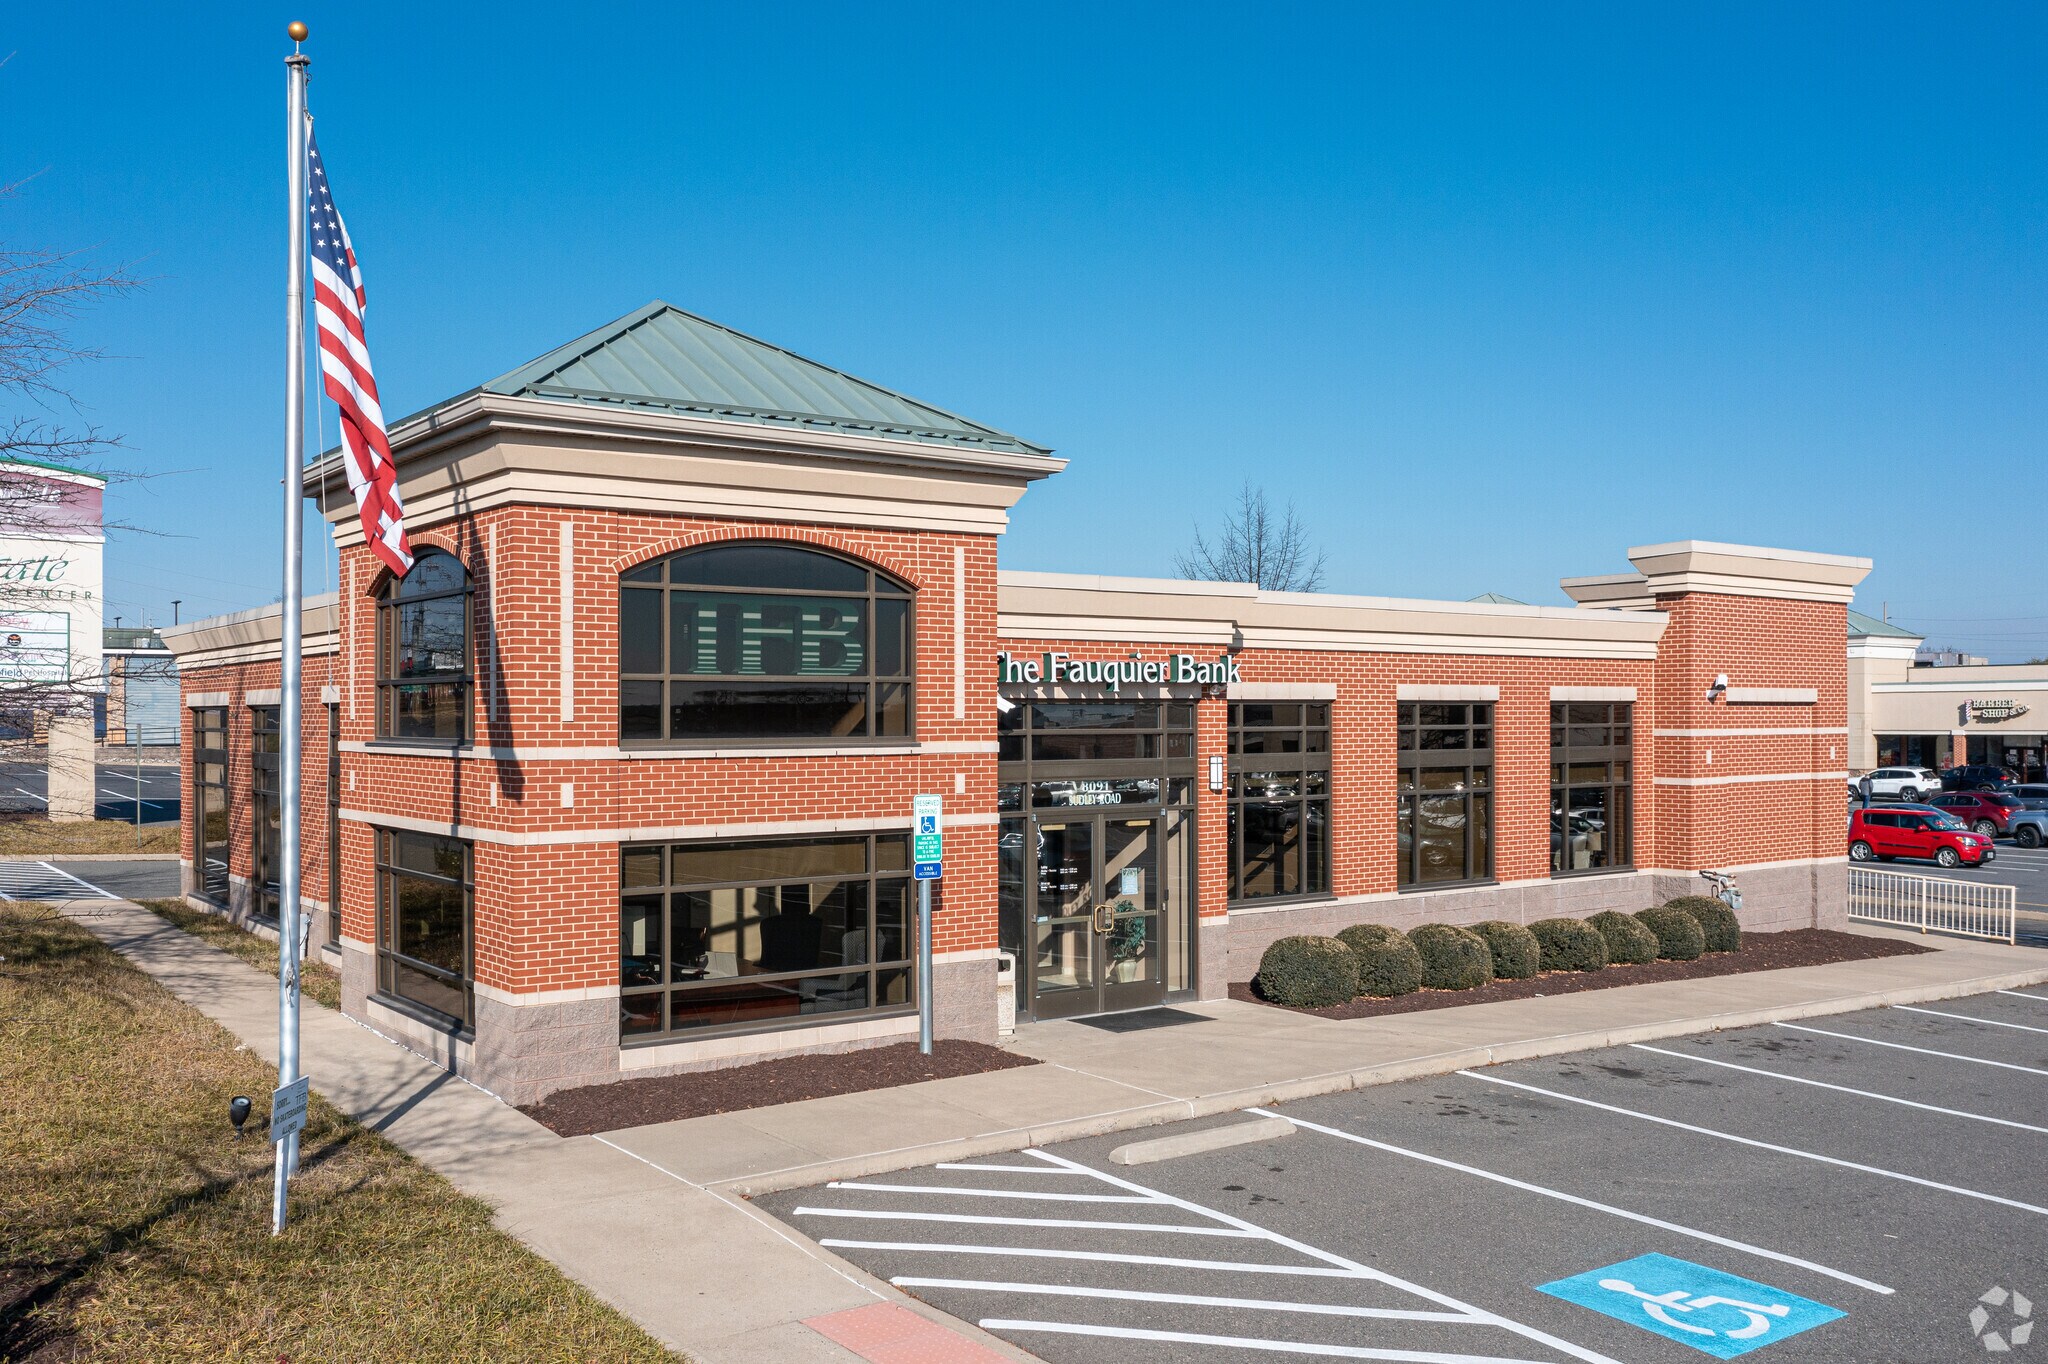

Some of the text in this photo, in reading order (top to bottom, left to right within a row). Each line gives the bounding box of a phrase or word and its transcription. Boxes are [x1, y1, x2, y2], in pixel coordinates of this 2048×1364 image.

[0, 555, 69, 582] ate
[1050, 652, 1169, 692] Fauquier
[1177, 654, 1242, 684] Bank
[1082, 781, 1110, 792] 8091
